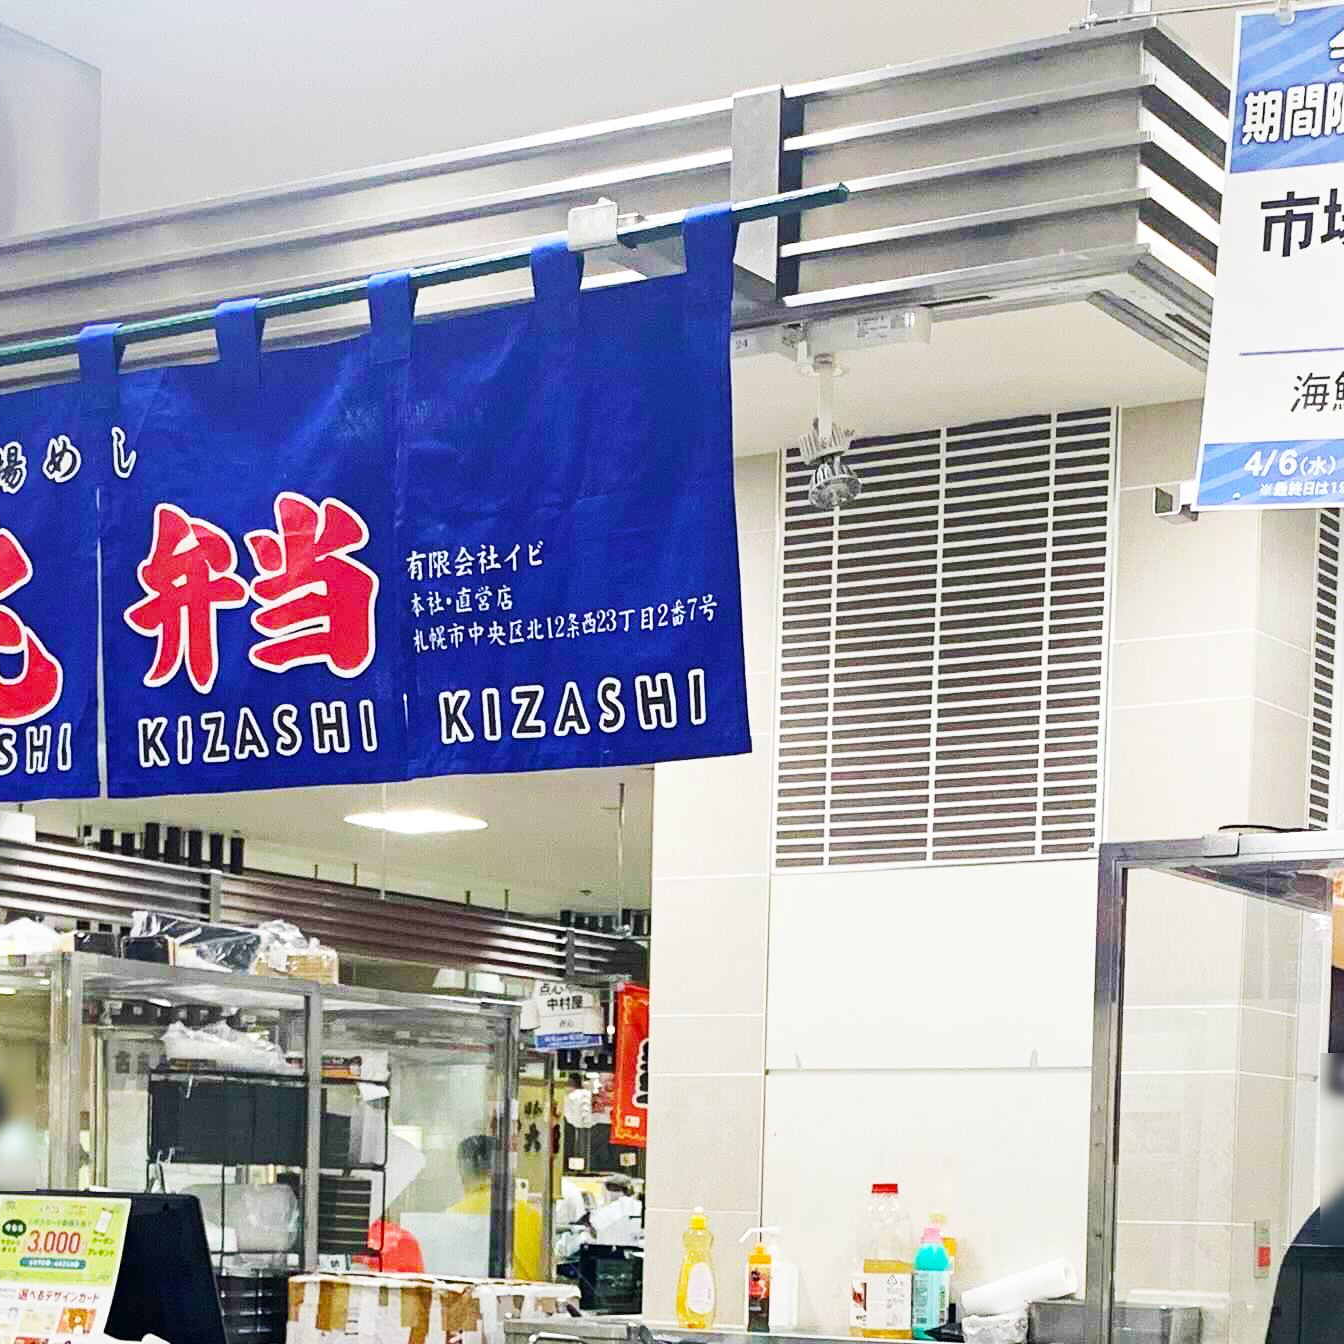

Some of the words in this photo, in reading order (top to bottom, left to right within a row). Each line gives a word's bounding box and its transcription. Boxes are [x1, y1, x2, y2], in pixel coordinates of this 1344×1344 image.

[123, 490, 380, 695] 弁当
[406, 540, 544, 581] 有限会社イビ
[138, 700, 378, 768] KIZASHI
[438, 667, 708, 745] KIZASHI
